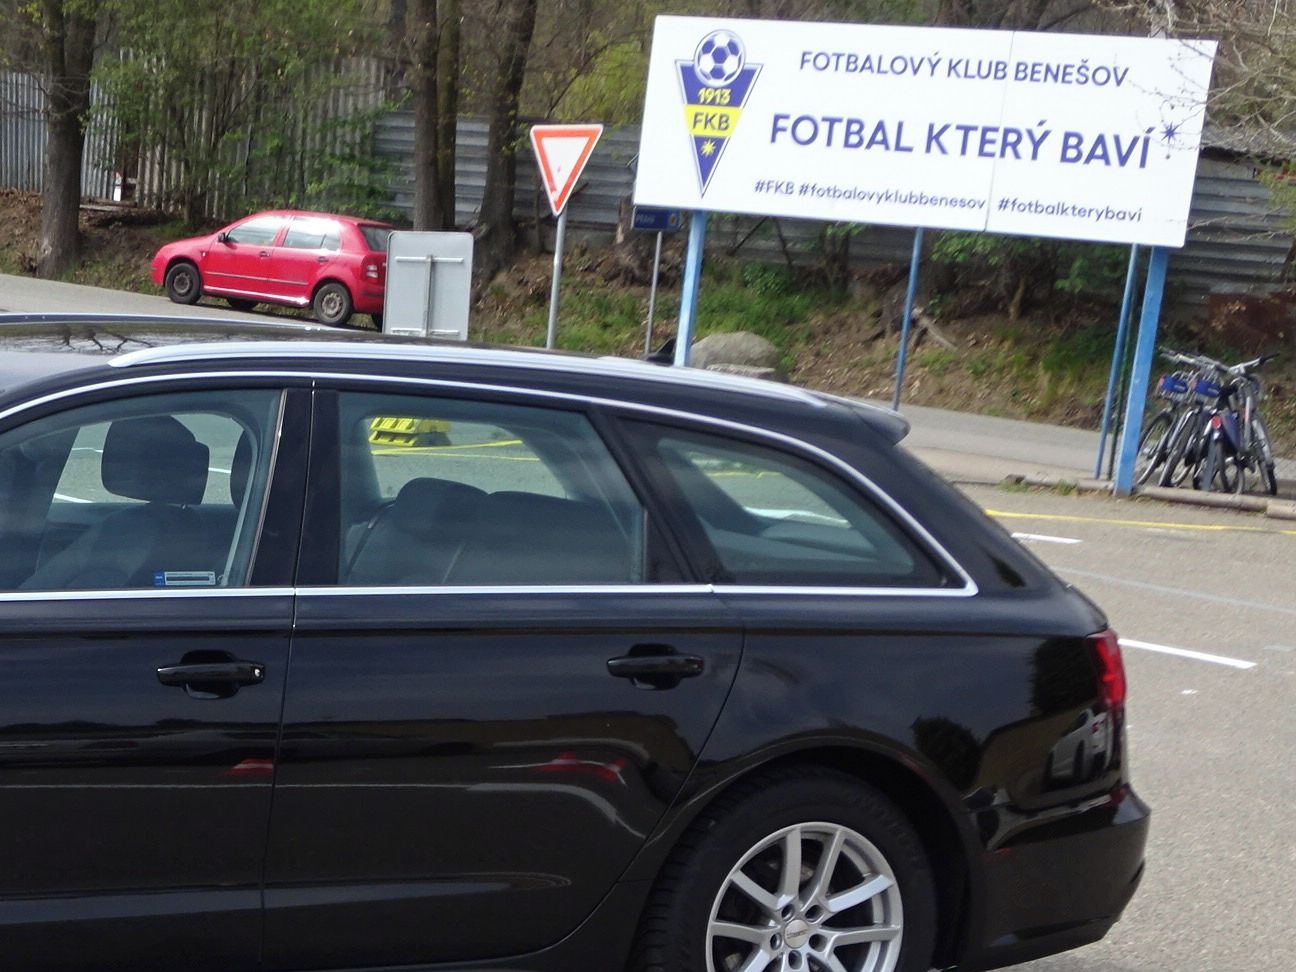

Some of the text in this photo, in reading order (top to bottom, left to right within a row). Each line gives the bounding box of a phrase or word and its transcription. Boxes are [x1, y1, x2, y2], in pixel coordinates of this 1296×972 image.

[799, 50, 1130, 88] FOTBALOVÝ KLUB BENEŠOV
[692, 111, 730, 131] FKB
[770, 113, 1156, 169] FOTBAL KTERÝ BAVÍ
[754, 179, 1143, 222] #FKB #fotbalovyklubbenesov #fotbalkterybavi
